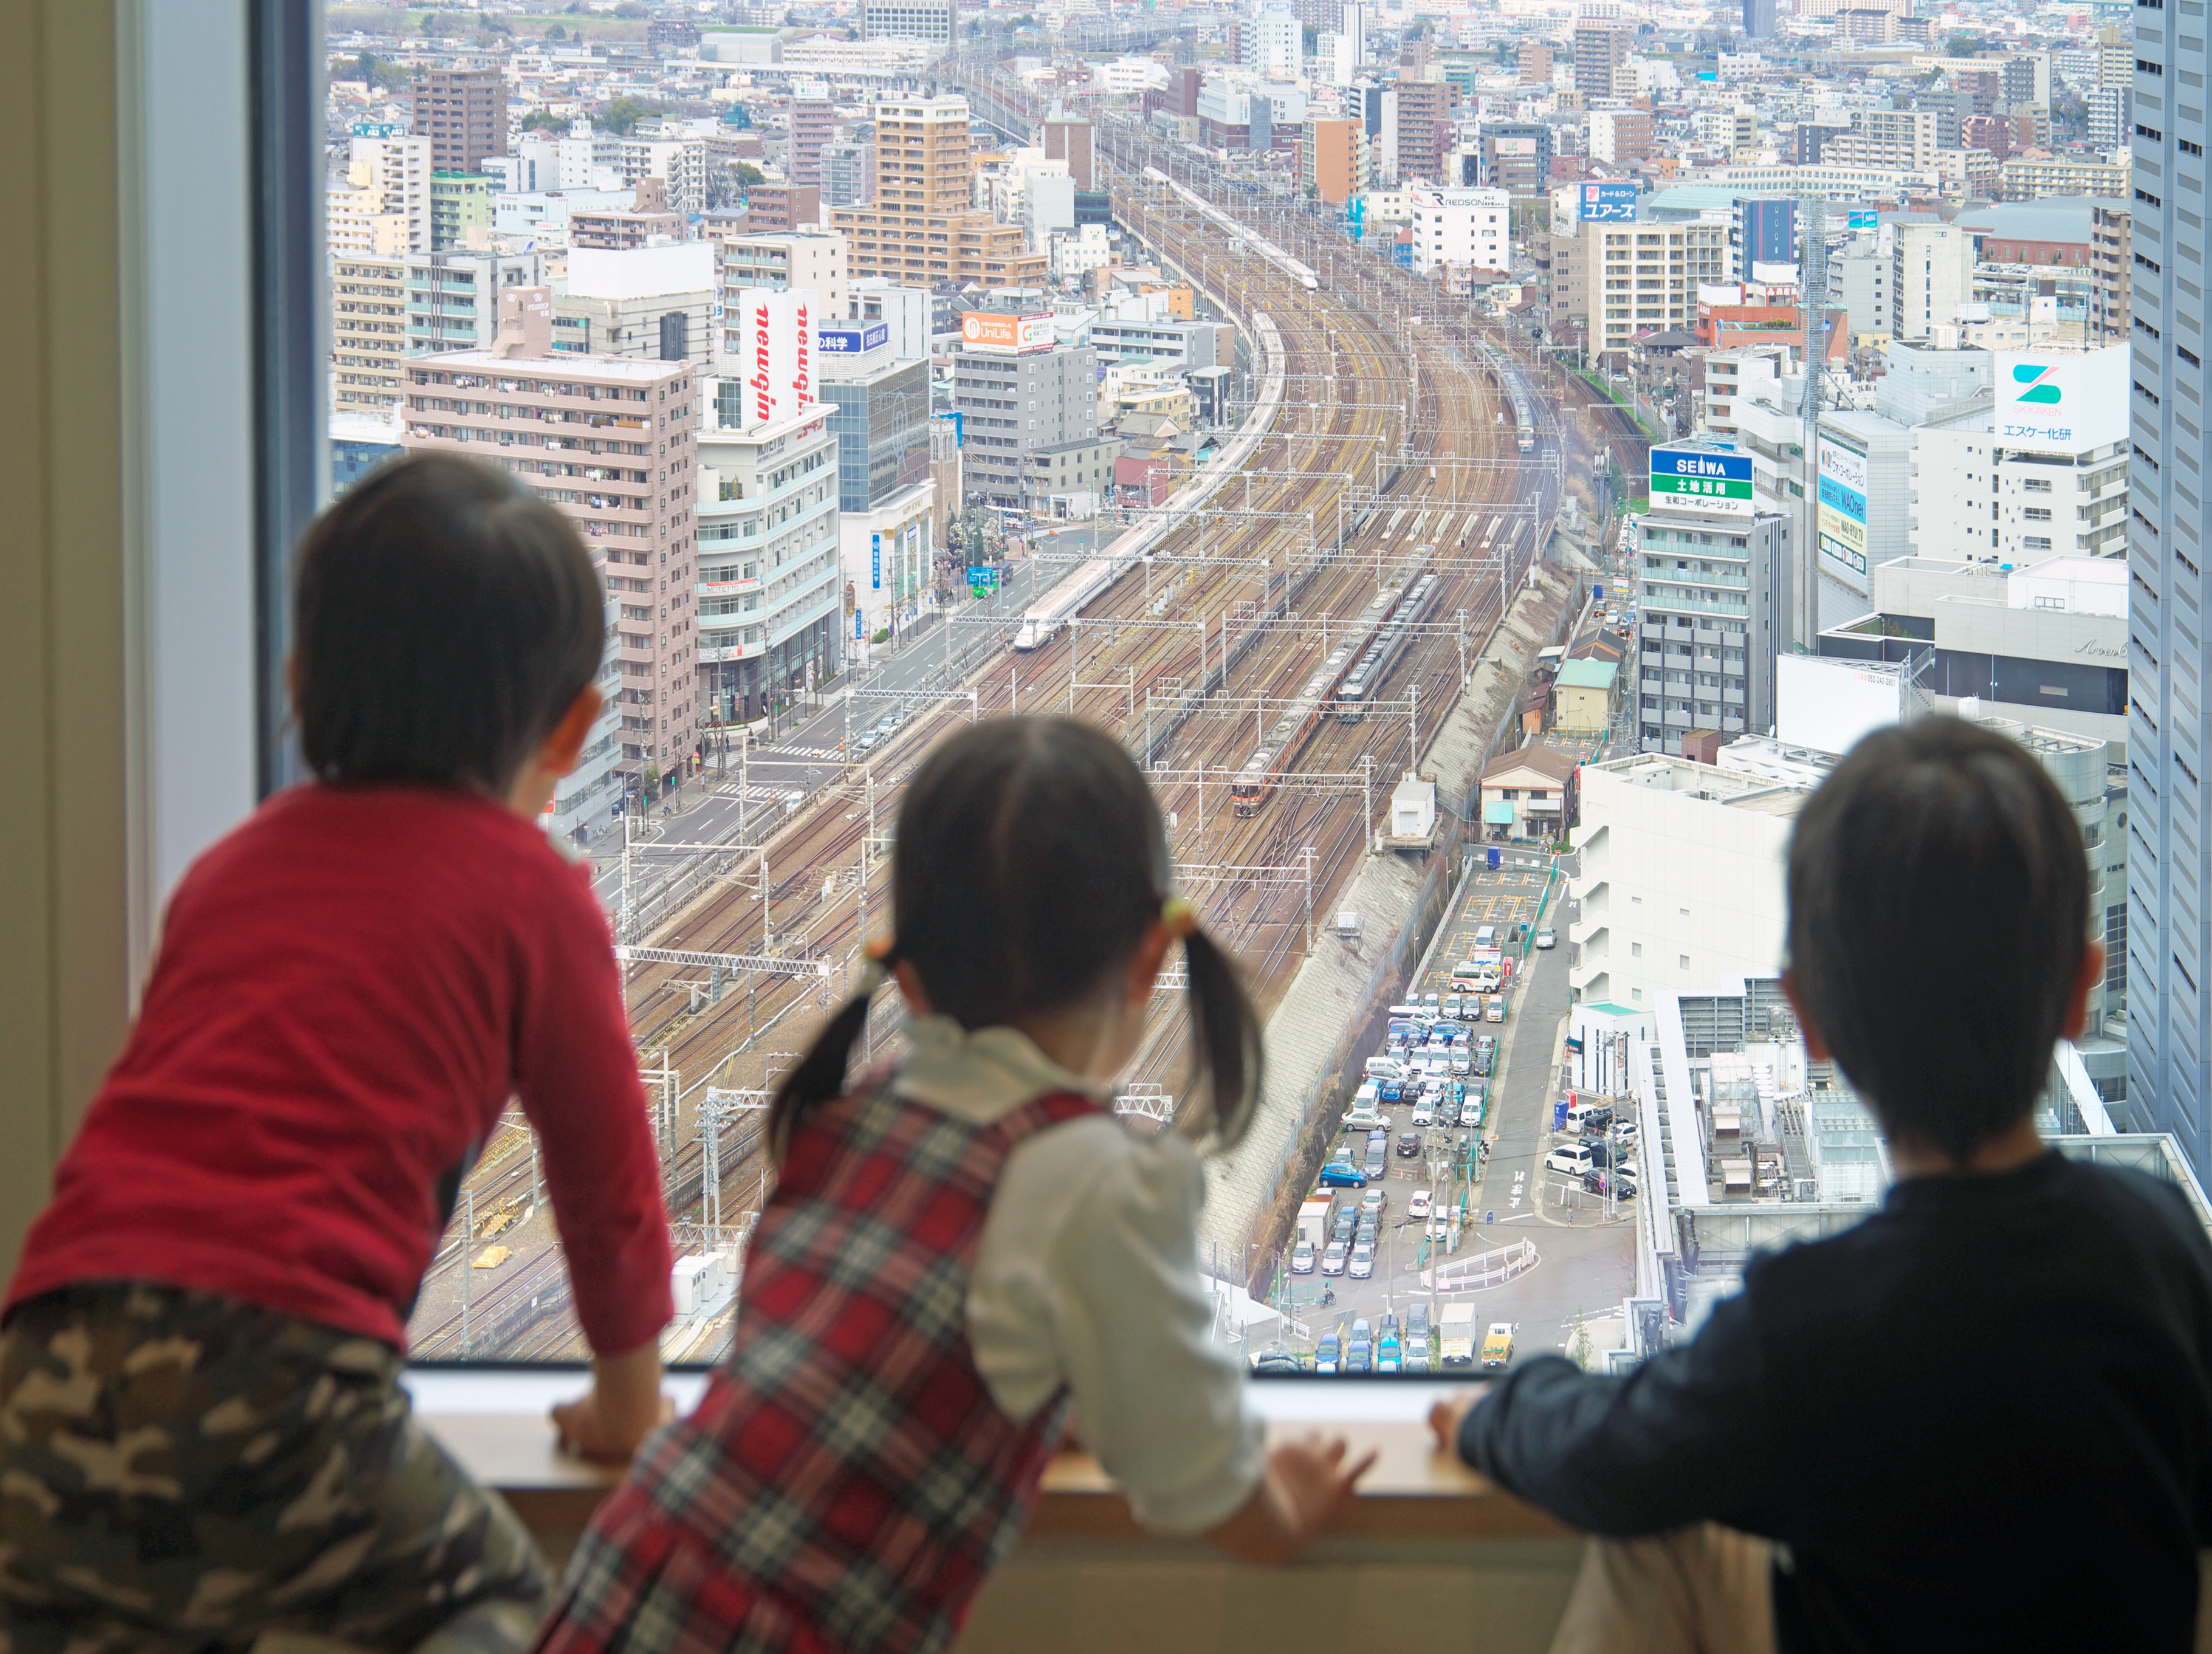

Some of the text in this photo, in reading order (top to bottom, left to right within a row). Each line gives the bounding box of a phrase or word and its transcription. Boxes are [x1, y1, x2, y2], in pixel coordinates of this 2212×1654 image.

[1584, 204, 1635, 218] ユアーズ
[750, 301, 776, 420] newgin
[2013, 405, 2062, 417] SK KAKEN
[2004, 425, 2072, 441] エスケー化研
[1677, 478, 1725, 495] 土地活用
[1665, 495, 1738, 510] 生和コーポレーション
[1841, 490, 1863, 518] WAOnet
[1867, 674, 1895, 686] 052-242-2801
[1508, 1170, 1525, 1208] 止まれ
